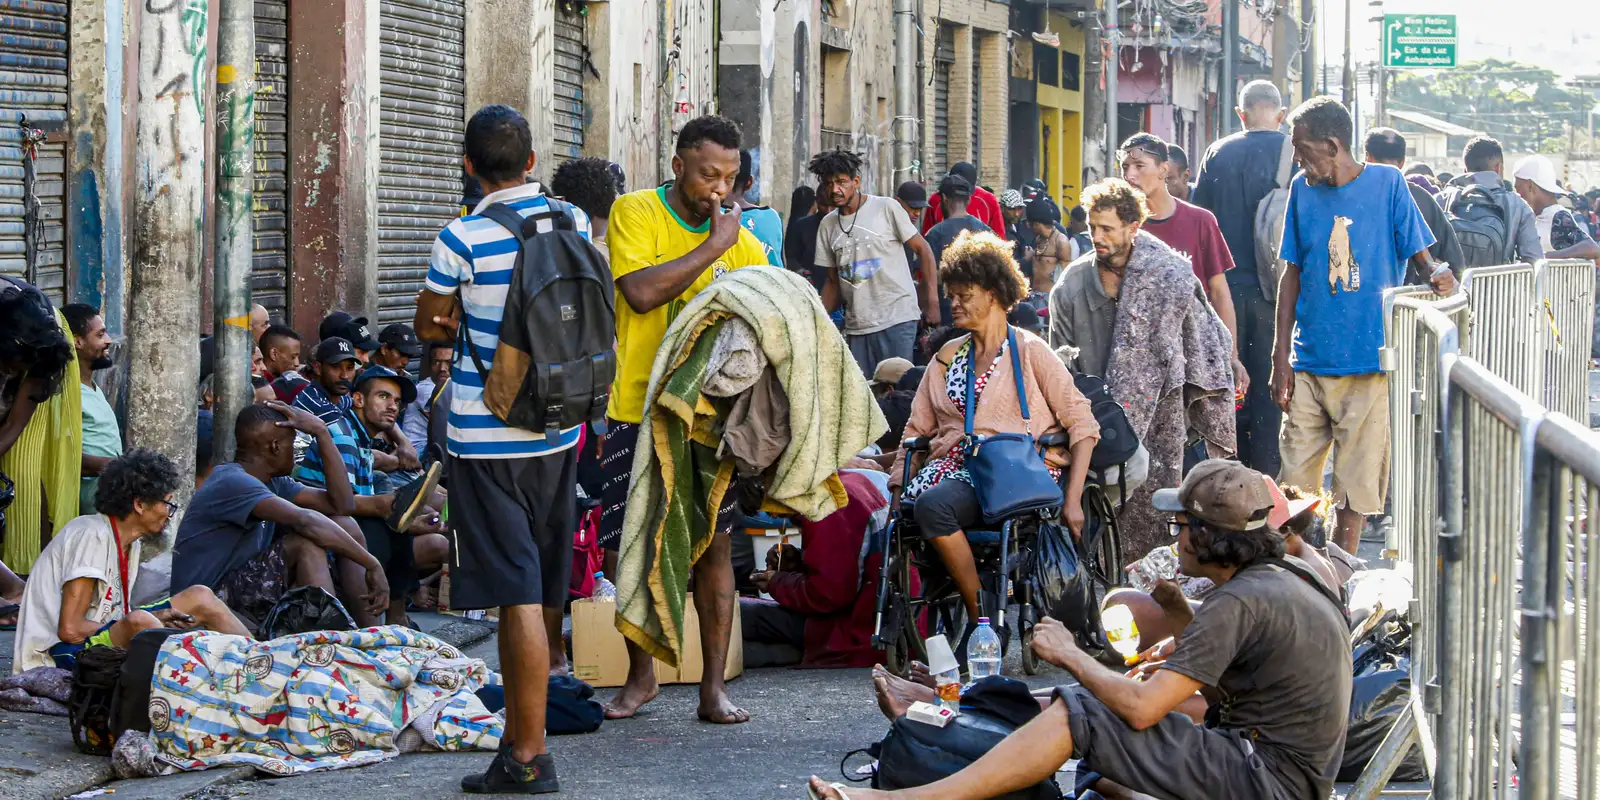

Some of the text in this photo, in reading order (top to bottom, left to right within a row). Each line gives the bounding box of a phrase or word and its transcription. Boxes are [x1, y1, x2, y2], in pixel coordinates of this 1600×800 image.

[1404, 17, 1448, 25] Bom Retiro
[1404, 46, 1447, 54] Est. da Luz
[338, 341, 350, 352] NY
